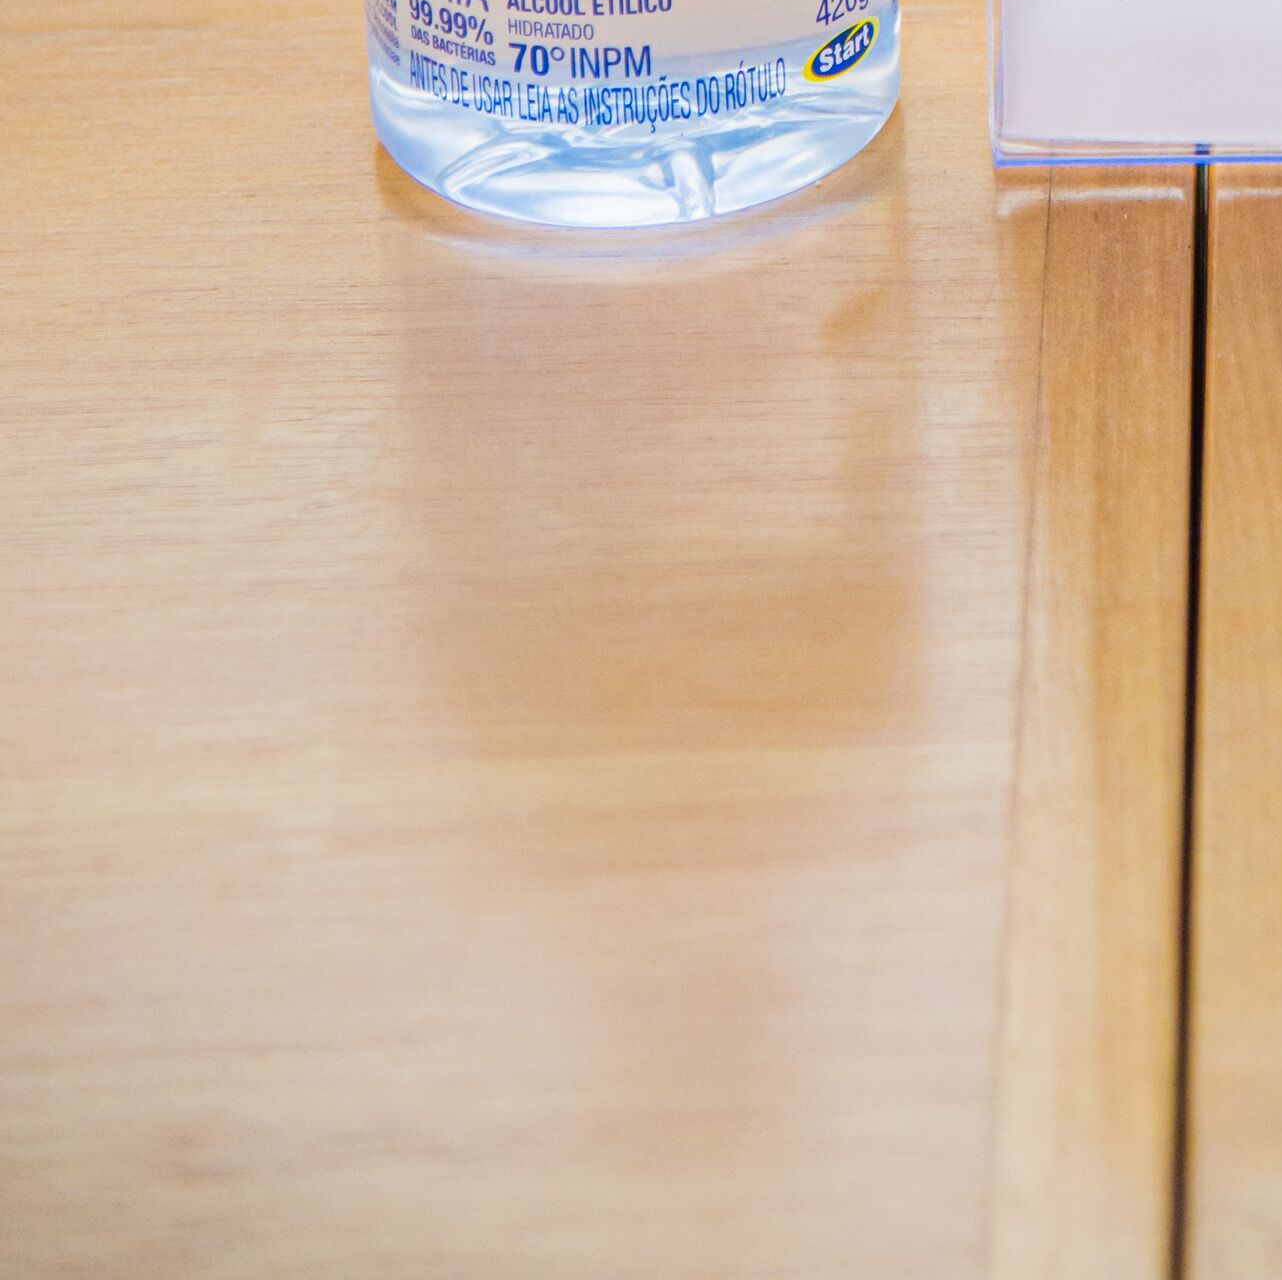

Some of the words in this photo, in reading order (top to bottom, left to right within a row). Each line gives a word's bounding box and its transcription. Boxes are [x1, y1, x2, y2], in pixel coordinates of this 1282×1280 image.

[411, 25, 430, 46] DAS
[433, 35, 496, 66] BACTÉRIAS
[508, 19, 594, 40] HIDRATADO
[819, 23, 871, 73] Start
[410, 50, 447, 102] ANTES
[450, 67, 469, 108] DE
[473, 75, 513, 119] USAR
[518, 83, 551, 122] LEIA
[557, 86, 579, 126] AS
[584, 76, 691, 133] INSTRUÇÕES
[697, 76, 720, 117] DO
[726, 57, 786, 111] RÓTULO
